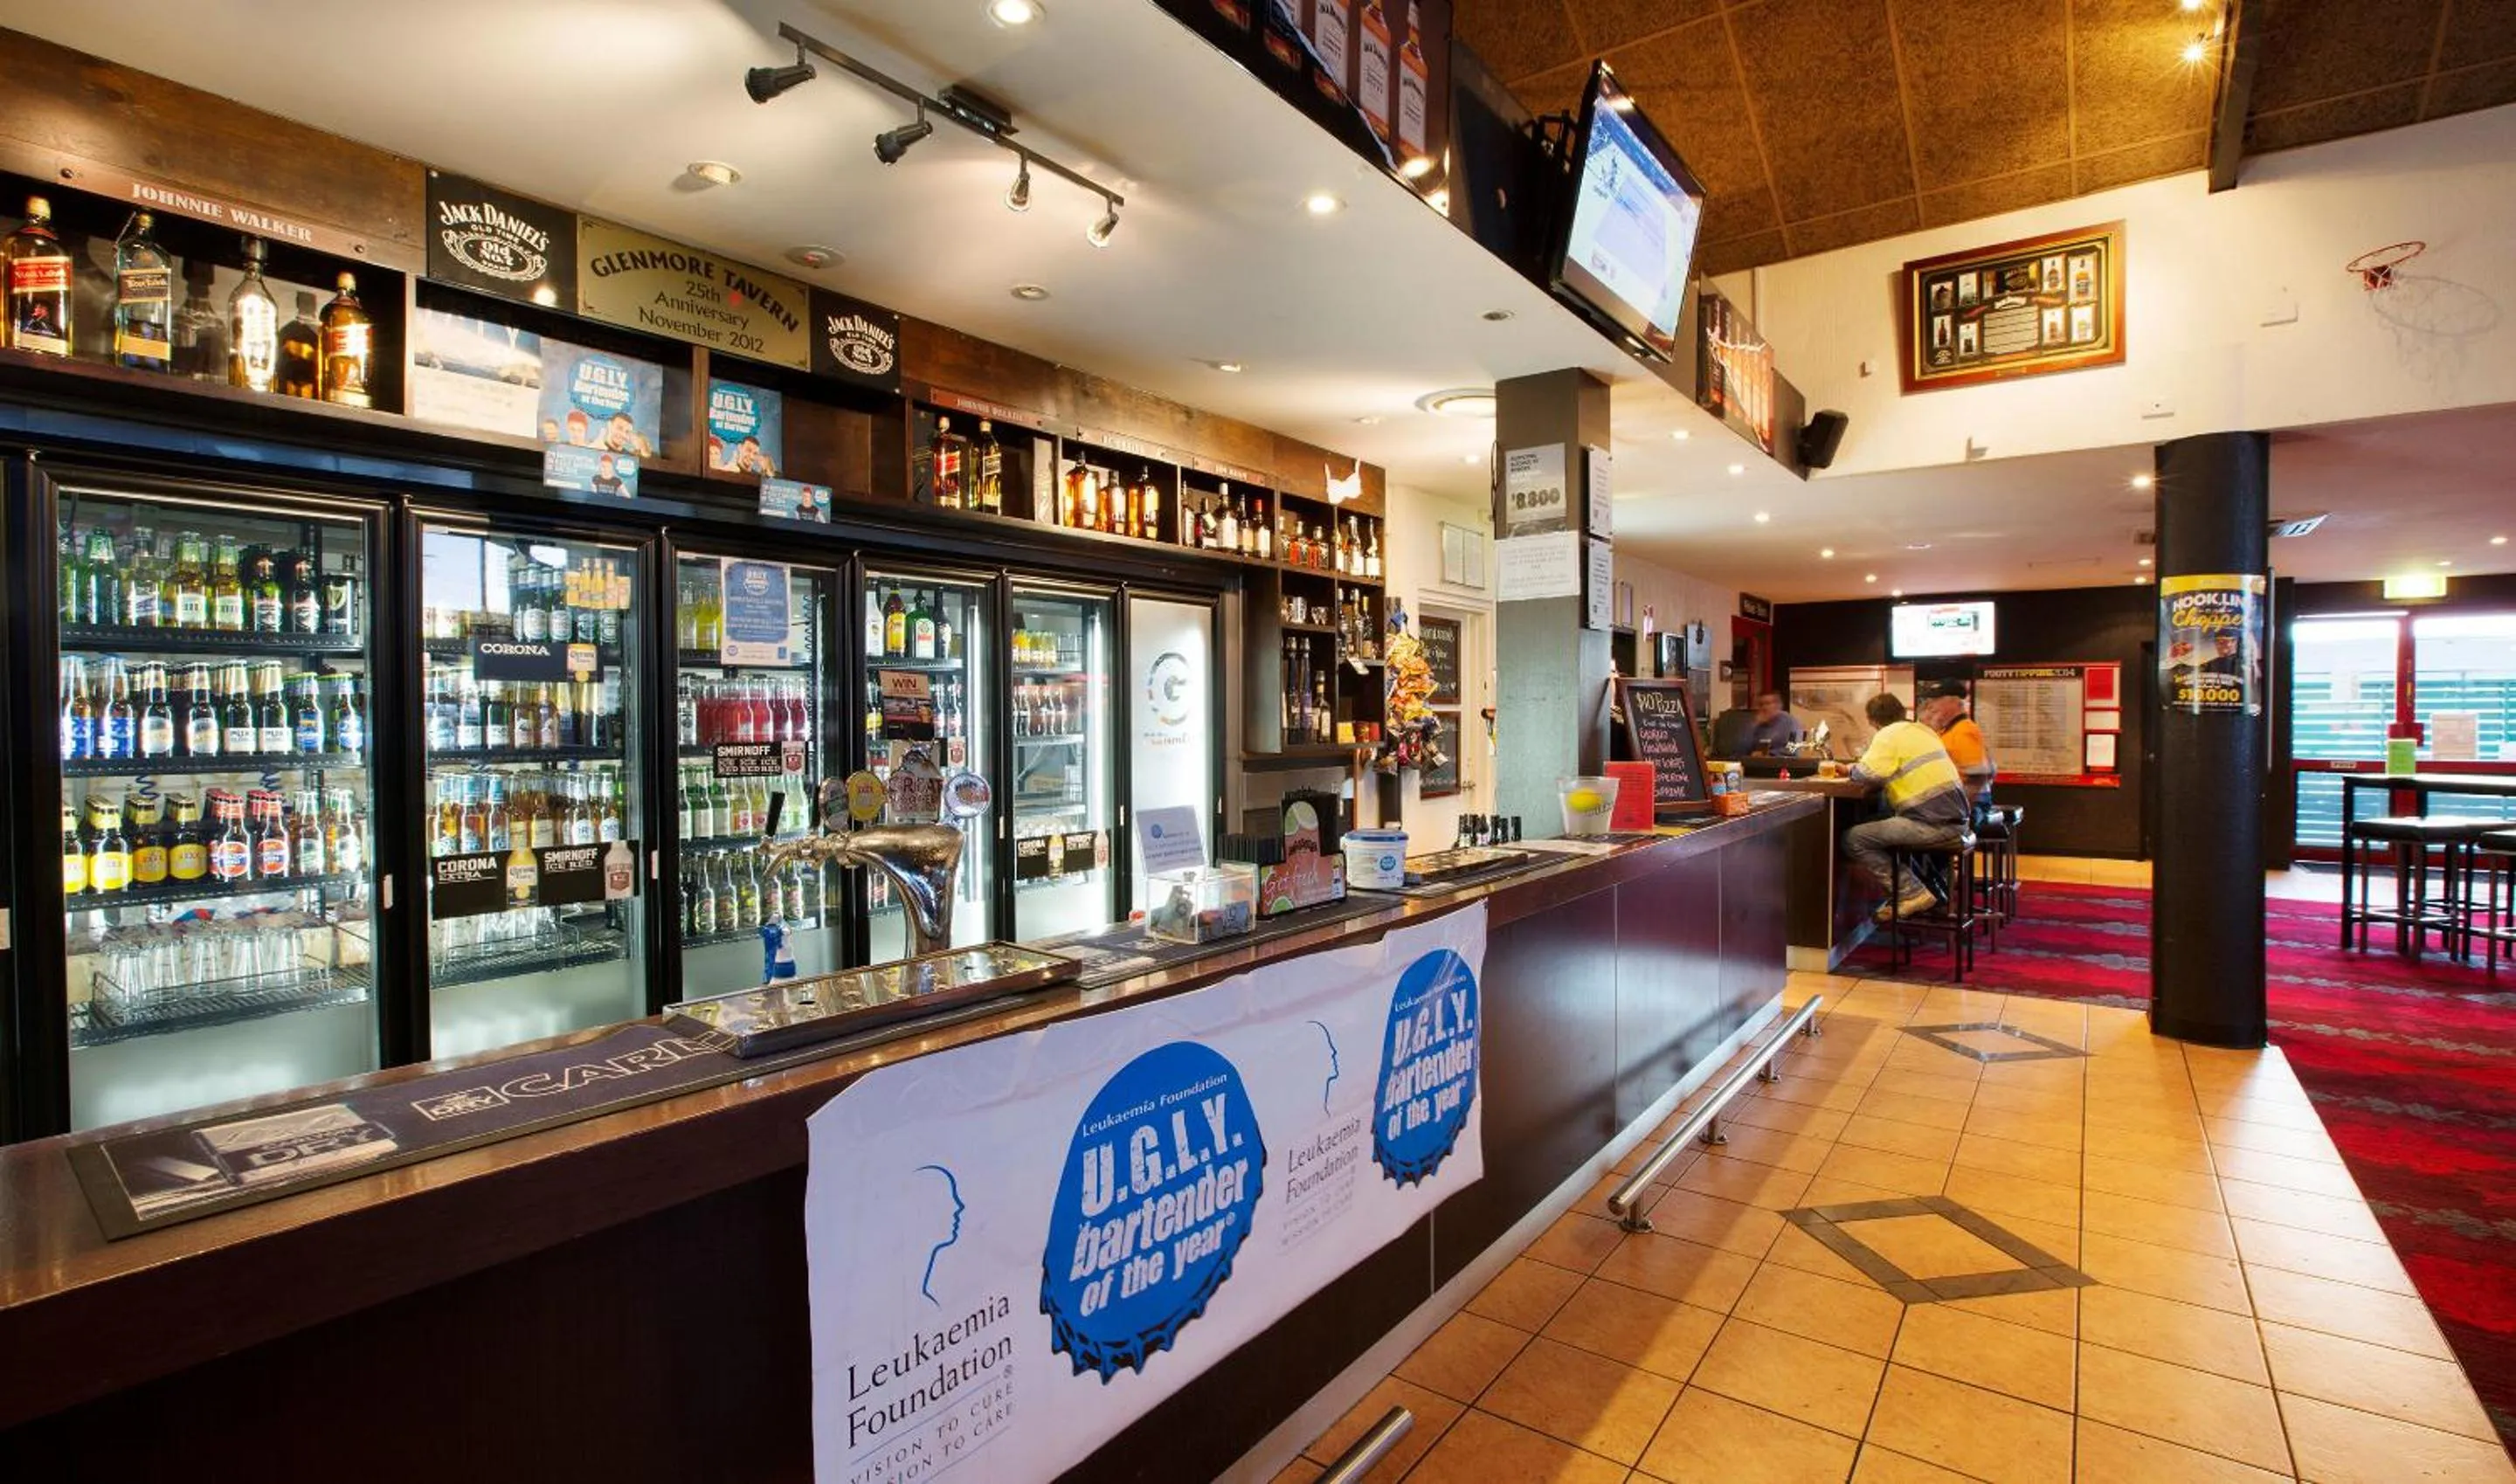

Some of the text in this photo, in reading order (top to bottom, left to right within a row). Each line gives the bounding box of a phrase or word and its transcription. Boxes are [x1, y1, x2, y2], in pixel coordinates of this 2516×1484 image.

[131, 183, 312, 242] JOHNNIE WALKER
[439, 201, 484, 225] JACK
[483, 202, 551, 252] DANIEL'S
[591, 250, 798, 333] GLENMORE TAVERN
[654, 291, 750, 330] Anniversary
[686, 280, 721, 303] 25th
[639, 307, 764, 353] November 2012
[827, 314, 895, 349] JACK DANIEL'S
[480, 643, 551, 656] CORONA
[892, 678, 917, 687] WIN
[717, 745, 771, 756] SMIRNOFF
[437, 856, 498, 873] CORONA
[544, 847, 598, 863] SMIRNOFF
[545, 859, 593, 872] ICE RED
[1393, 989, 1474, 1067] U.G.L.Y.
[1383, 1038, 1474, 1112] bartender
[1082, 1073, 1227, 1138] Leukaemia Foundation
[1387, 1108, 1403, 1142] of
[1407, 1096, 1430, 1130] the
[248, 1128, 373, 1168] DRY
[1082, 1093, 1243, 1217] U.G.L.Y.
[1289, 1116, 1361, 1174] Leukaemia
[1286, 1146, 1358, 1204] Foundation
[1069, 1157, 1248, 1282] bartender
[1080, 1269, 1114, 1316] of
[1121, 1251, 1165, 1299] the
[847, 1294, 1010, 1403] Leukaemia
[847, 1336, 1013, 1449] Foundation
[937, 1418, 959, 1439] TO
[971, 1383, 1013, 1418] CURE
[942, 1436, 964, 1458] TO
[974, 1402, 1013, 1438] CARE
